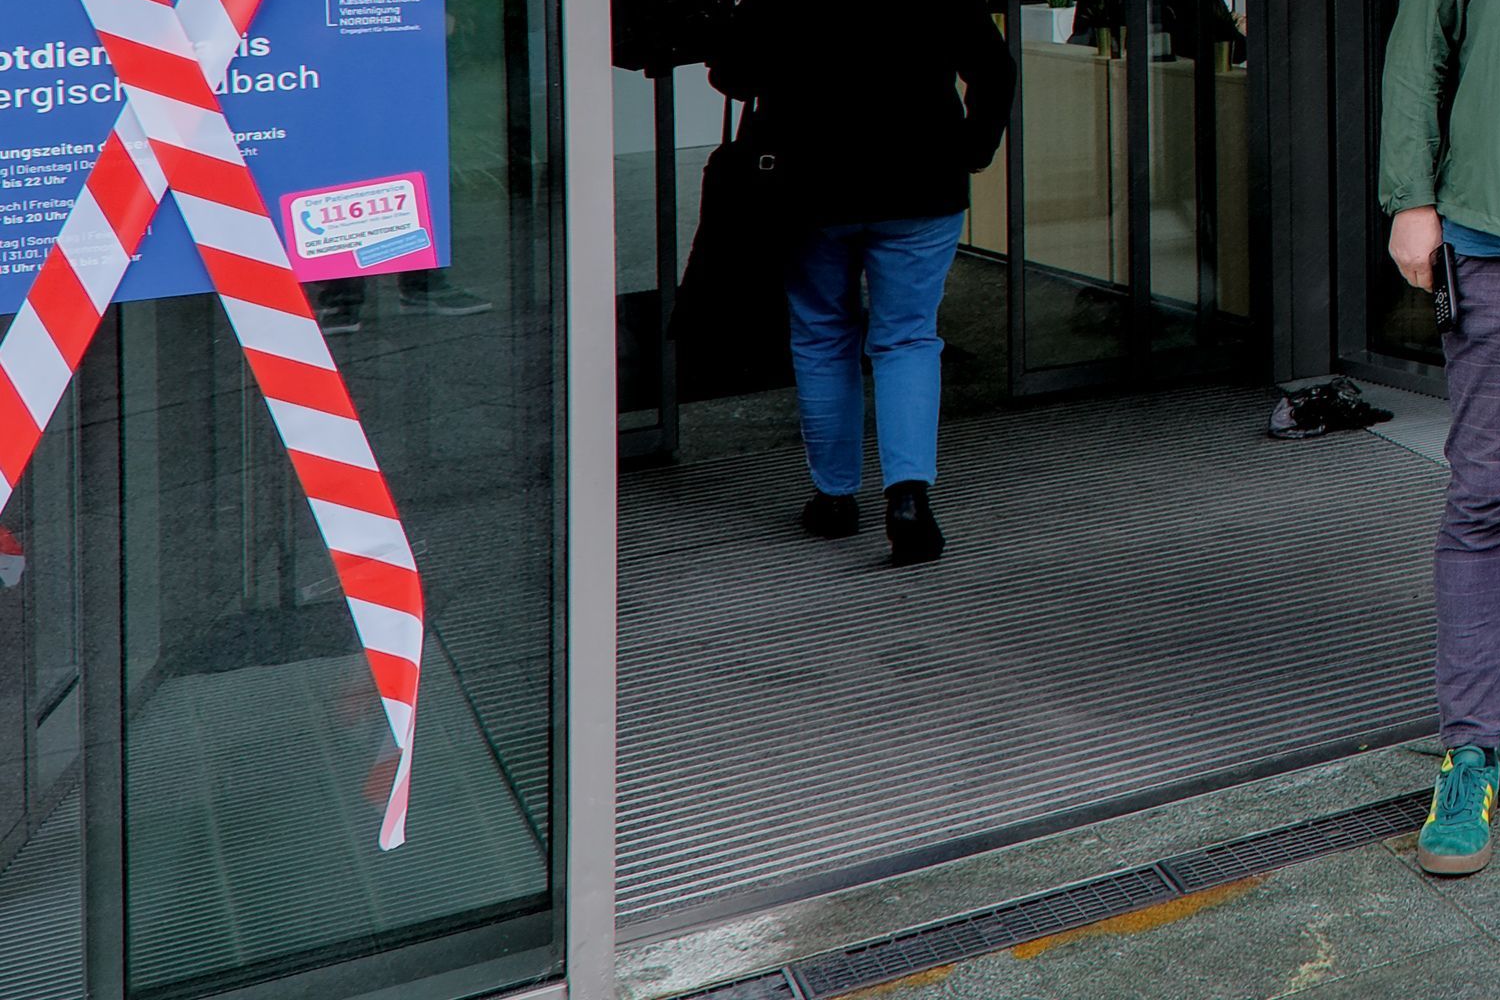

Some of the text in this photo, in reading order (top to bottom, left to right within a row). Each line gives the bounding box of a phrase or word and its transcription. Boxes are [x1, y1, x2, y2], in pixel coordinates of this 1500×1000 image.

[338, 5, 402, 16] Vereinigung
[339, 15, 402, 27] NORDRHEIN
[16, 162, 72, 176] Dienstag
[2, 175, 68, 189] bis 22 Uhr
[2, 210, 69, 225] bis 20 Uhr
[12, 263, 36, 273] Uhr
